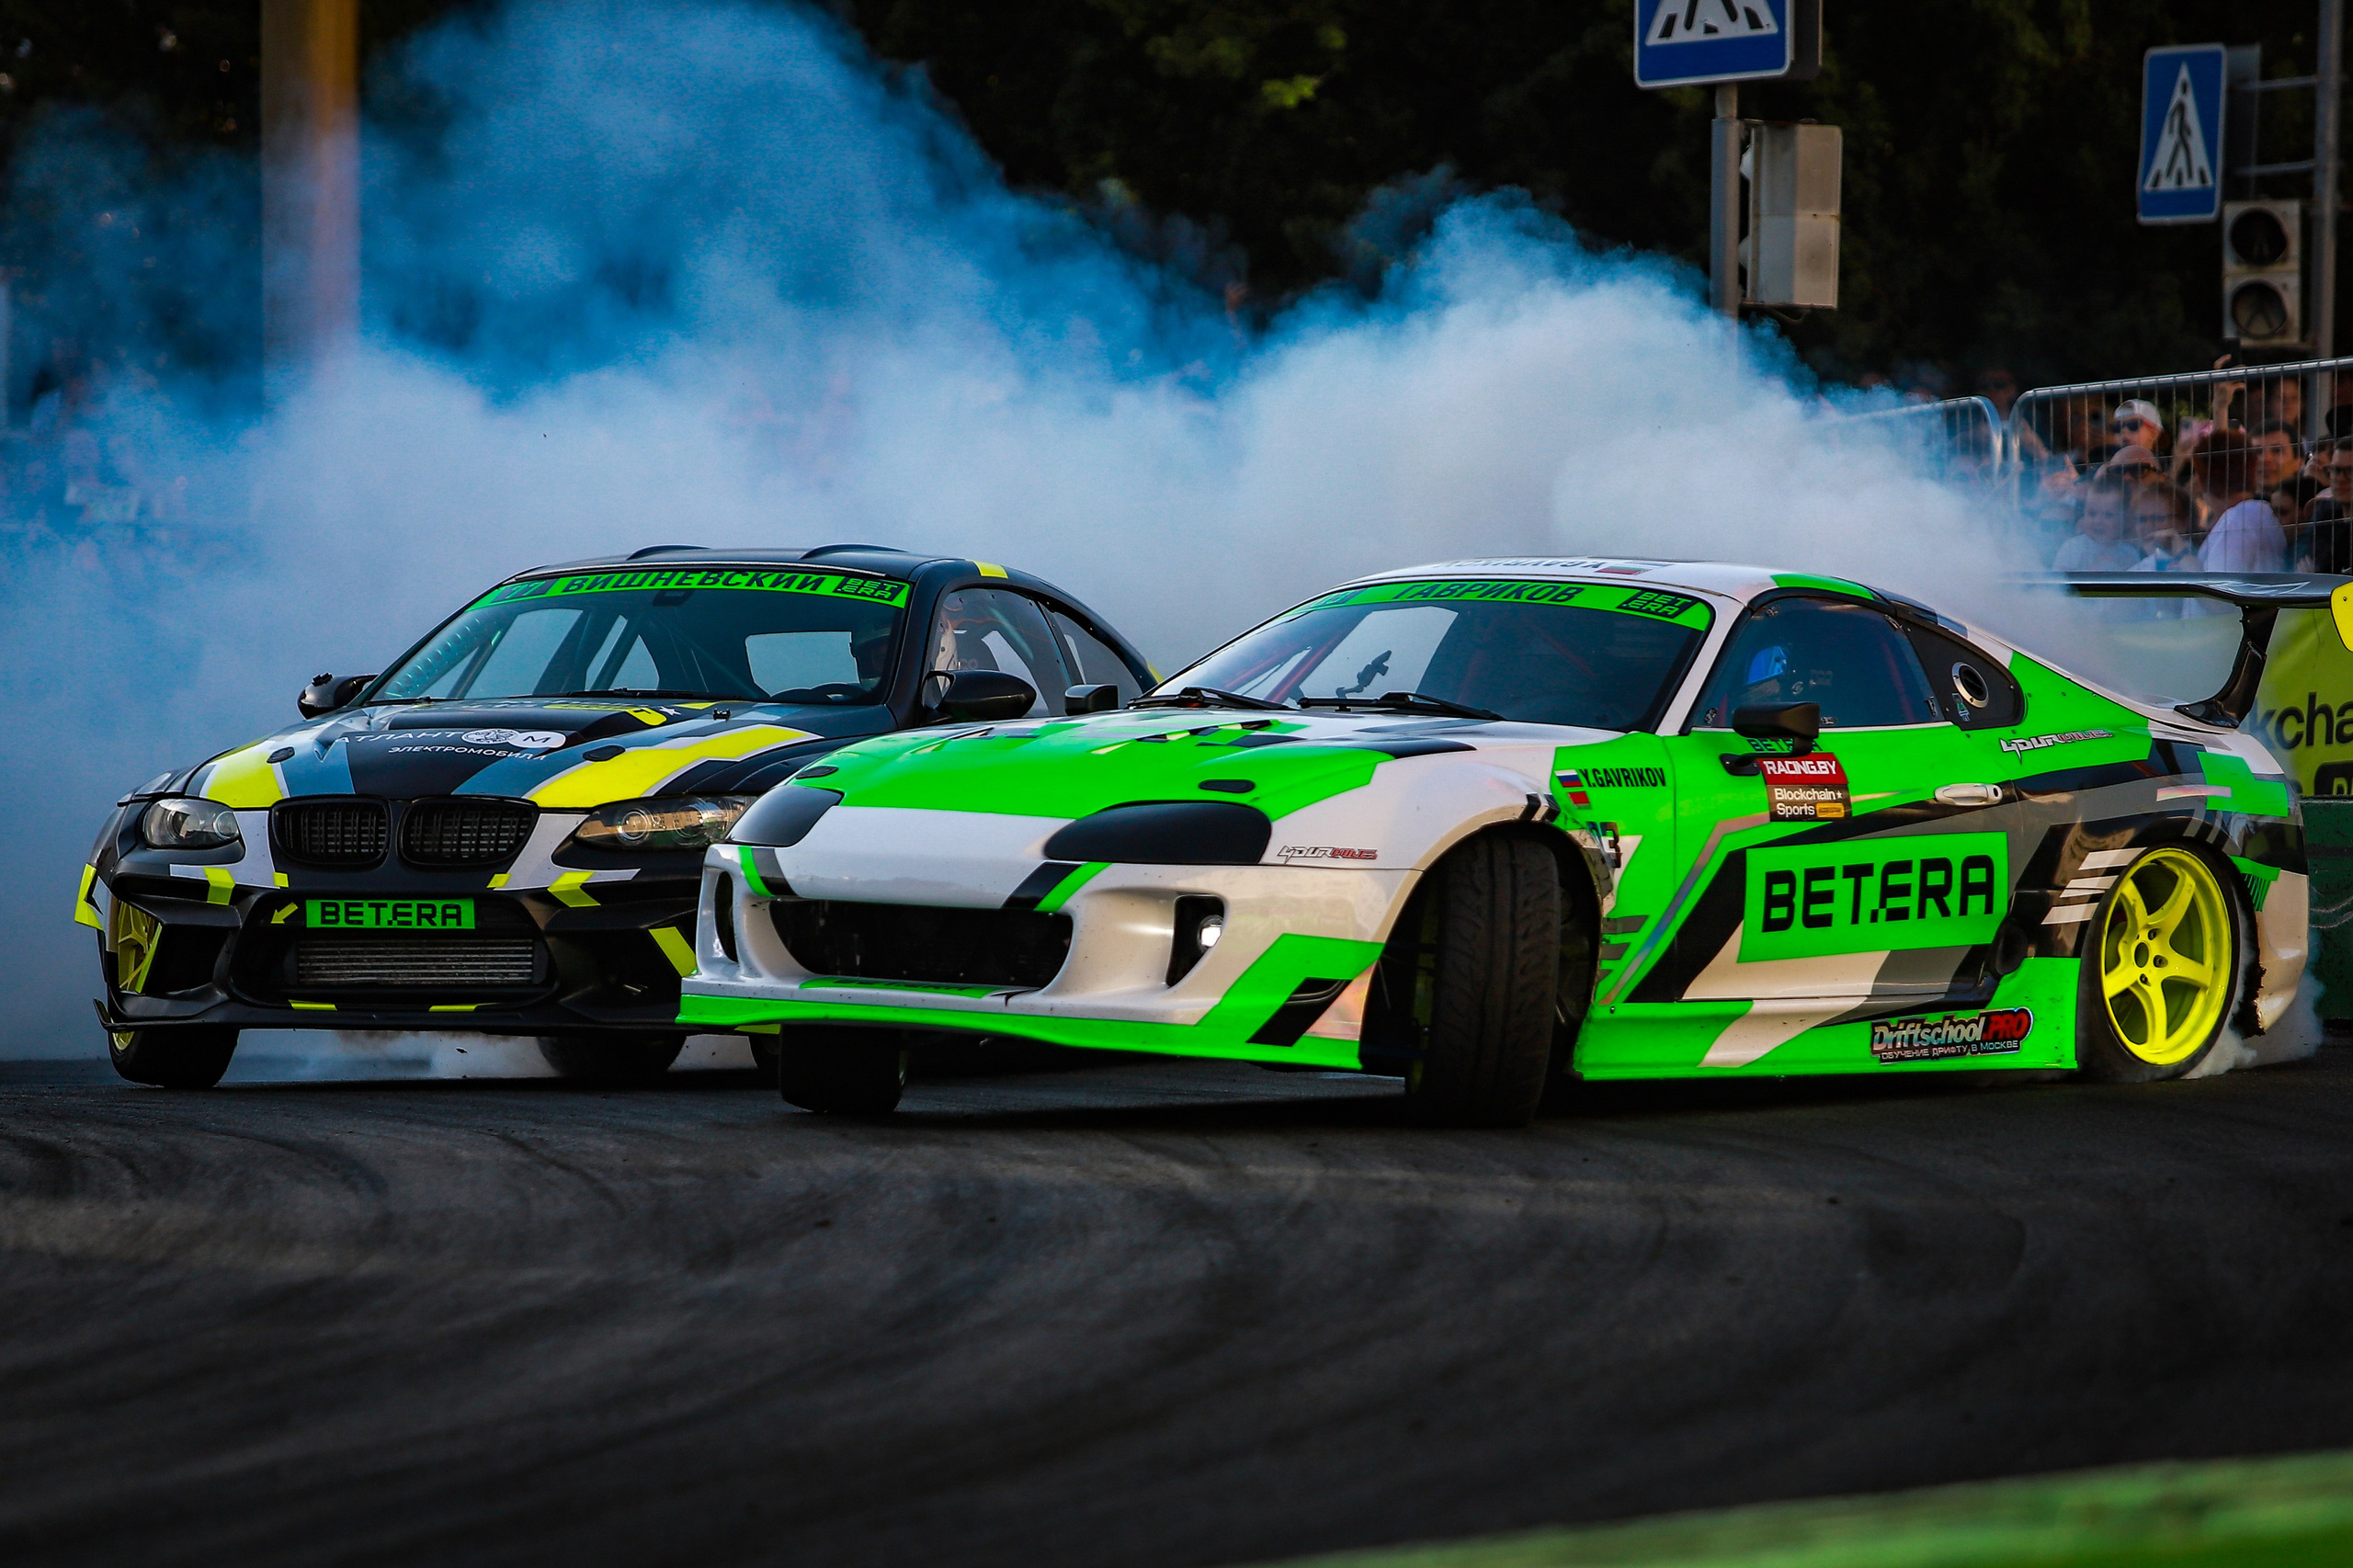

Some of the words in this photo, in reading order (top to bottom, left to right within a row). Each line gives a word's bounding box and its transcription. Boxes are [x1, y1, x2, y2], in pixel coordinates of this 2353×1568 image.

[847, 578, 898, 590] BET
[1392, 581, 1585, 602] ГАВРИКОВ
[1637, 592, 1691, 606] BET
[334, 731, 464, 743] АТЛАНТ
[1578, 767, 1666, 788] Y.GAVRIKOV
[1774, 788, 1836, 801] Blockchain
[1776, 802, 1815, 817] Sports
[1881, 1049, 1930, 1060] ОБУЧЕНИЕ
